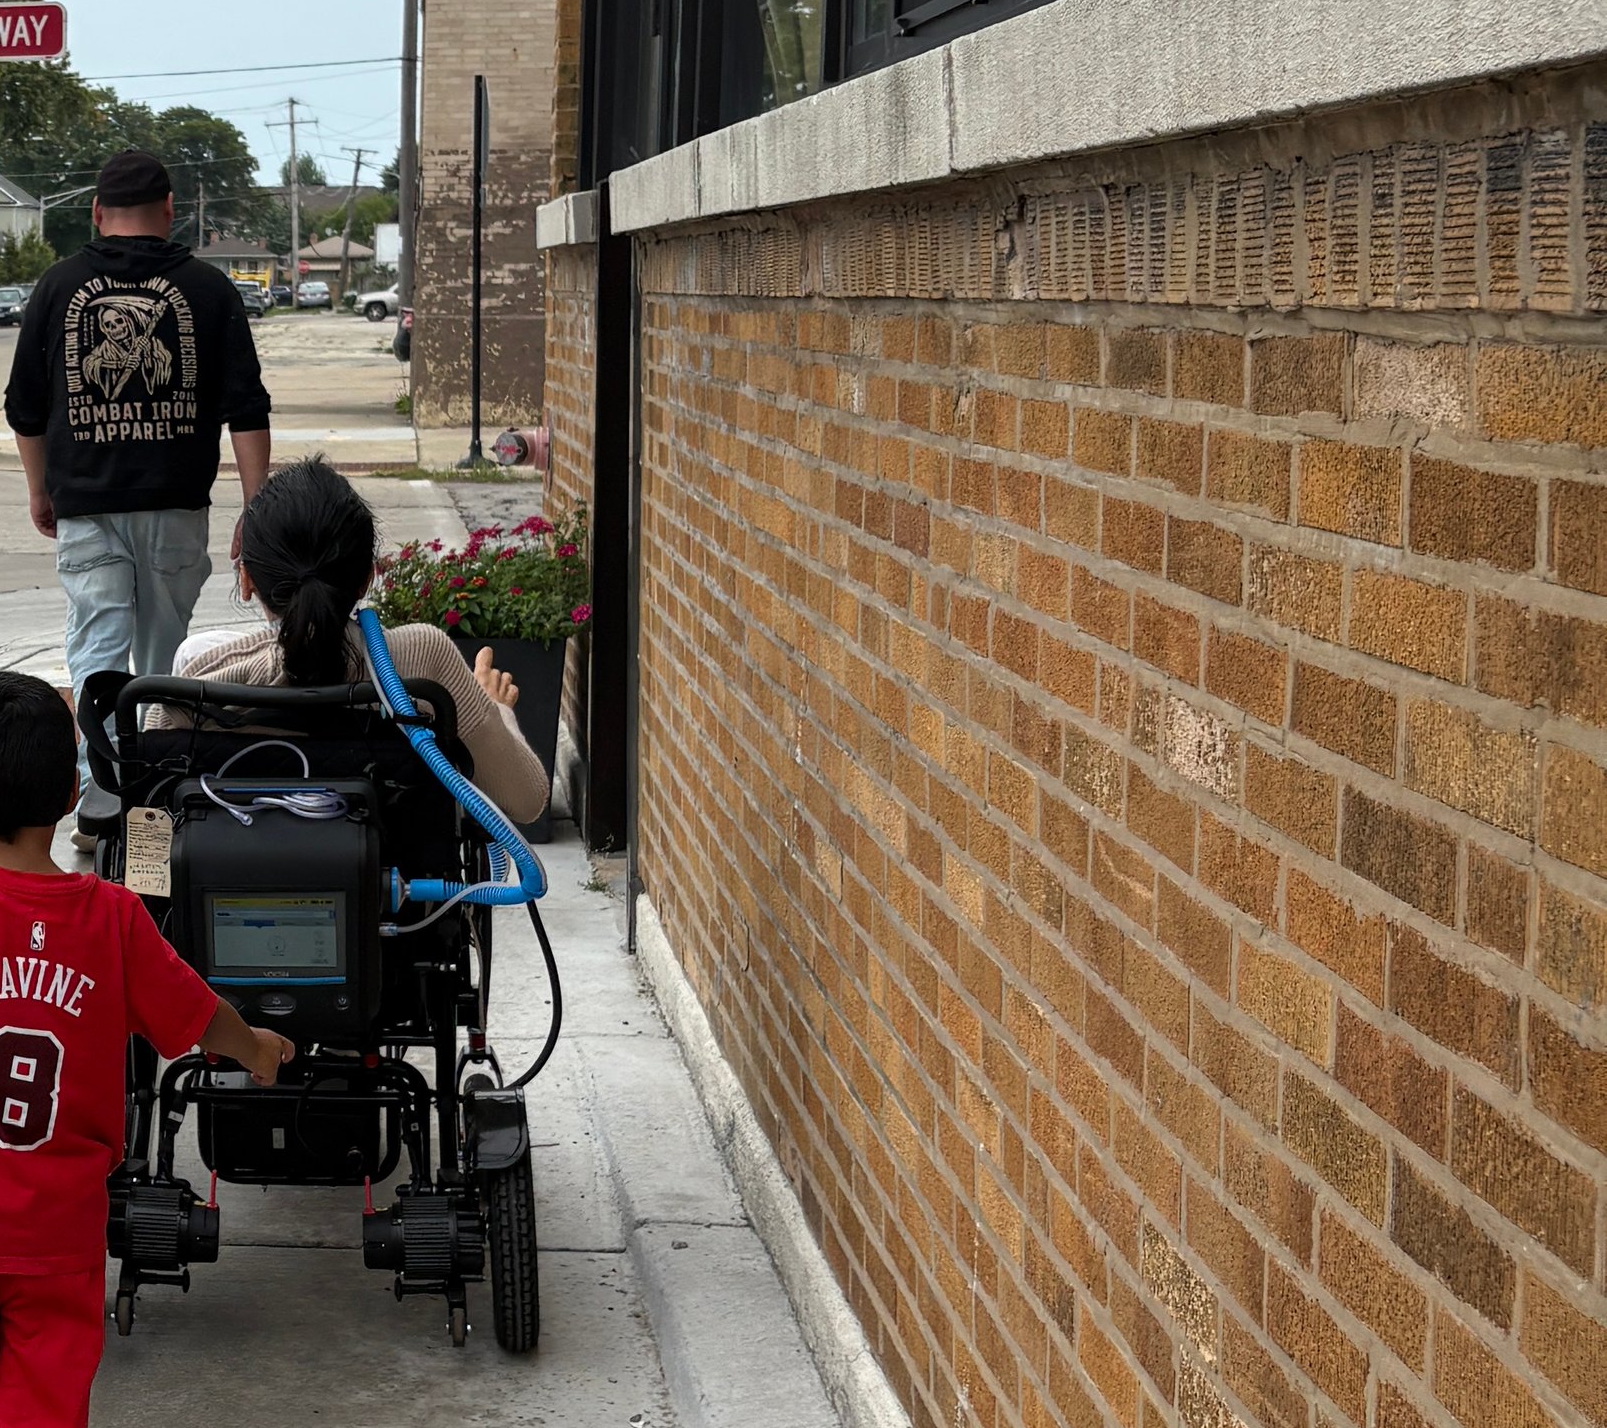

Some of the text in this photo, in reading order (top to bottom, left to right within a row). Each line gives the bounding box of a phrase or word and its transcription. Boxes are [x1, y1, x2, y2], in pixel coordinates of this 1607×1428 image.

[84, 277, 104, 294] TO
[64, 288, 91, 331] VICTIM
[164, 286, 195, 334] FUCKING
[65, 331, 80, 367] ACTING
[179, 335, 198, 389] DECISIONS
[66, 370, 84, 393] QUIT
[68, 401, 197, 426] COMBAT IRON
[94, 421, 175, 443] APPAREL
